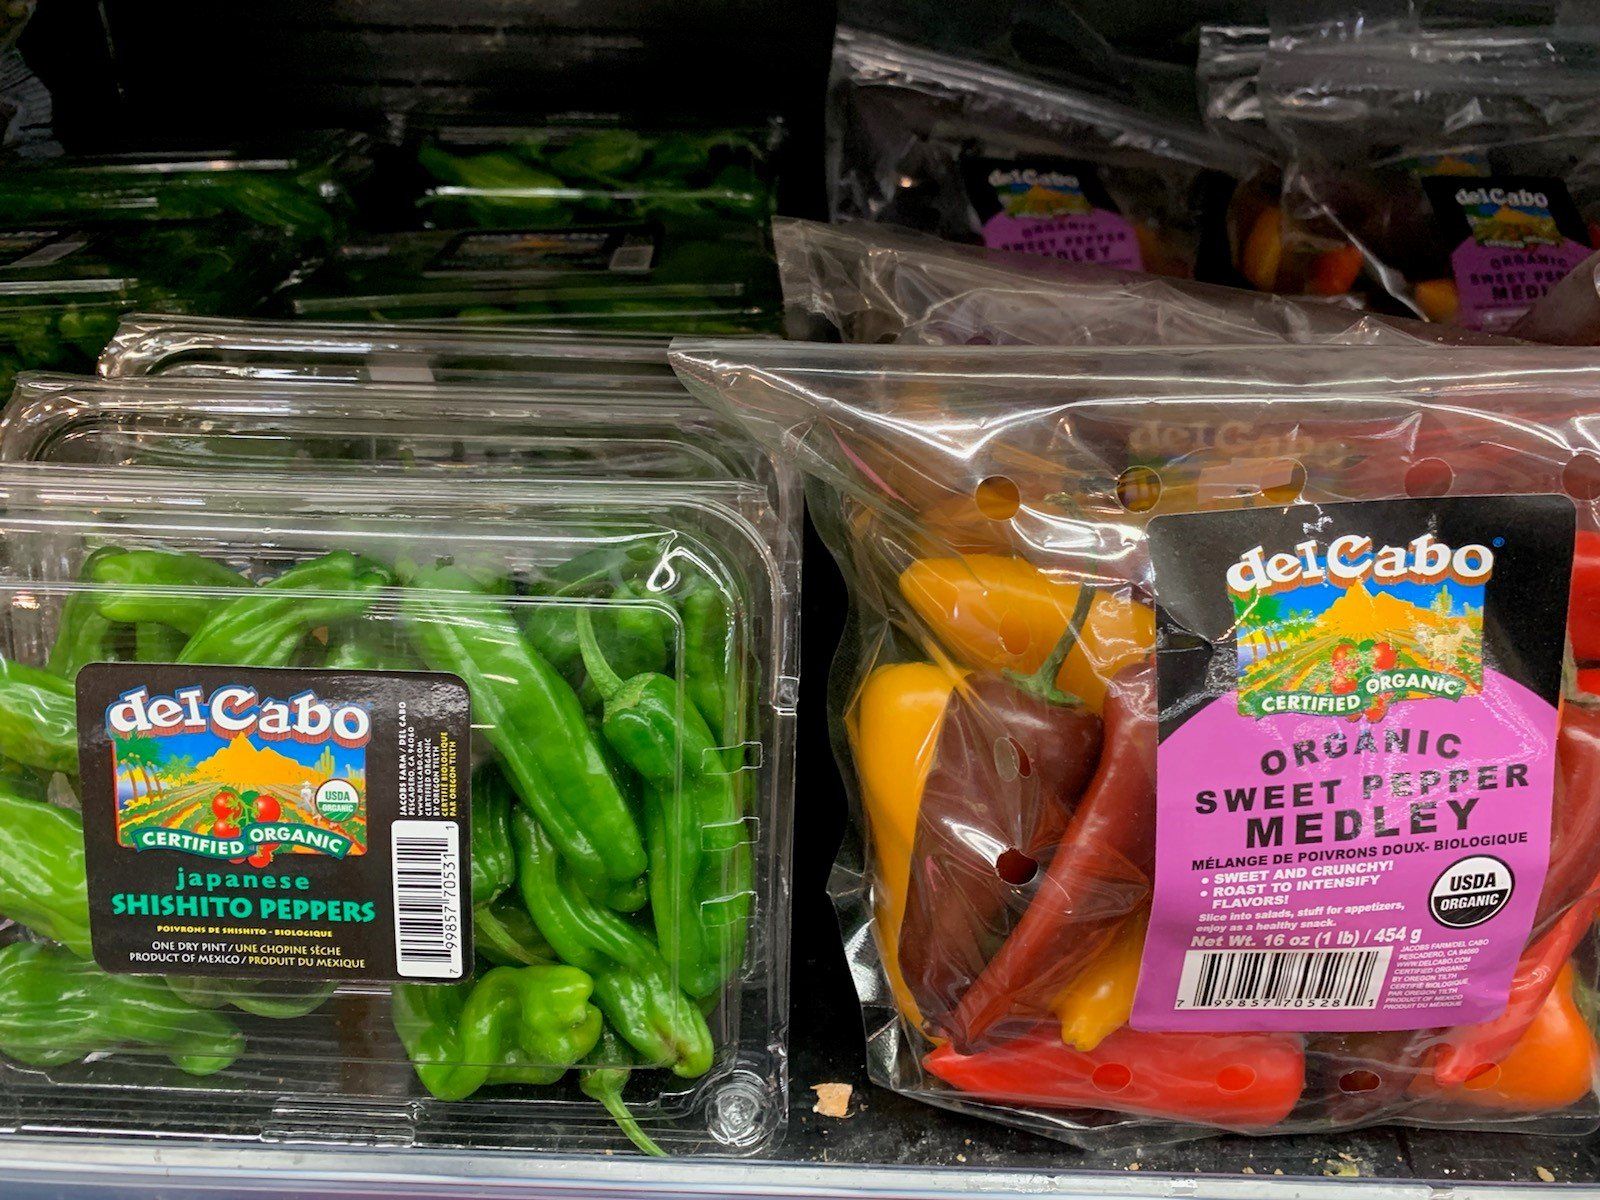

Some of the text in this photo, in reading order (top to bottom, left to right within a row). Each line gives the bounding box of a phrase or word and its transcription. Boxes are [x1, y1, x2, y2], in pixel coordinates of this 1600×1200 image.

[1261, 673, 1459, 712] CERTIFIED ORGANIC
[398, 701, 406, 727] CABO
[408, 756, 415, 767] CA
[440, 731, 448, 782] BIOLOGIQUE
[1260, 728, 1462, 776] ORGANIC
[399, 754, 407, 780] FARM
[325, 790, 350, 802] USDA
[399, 782, 407, 816] JACOBS
[424, 776, 432, 816] CERTIFIED
[1195, 763, 1530, 815] SWEET PEPPER
[321, 803, 354, 814] ORGANIC
[433, 805, 440, 816] BY
[449, 801, 457, 817] PAR
[1246, 797, 1480, 849] MEDLEY
[142, 827, 343, 855] CERTIFIED ORGANIC
[1191, 857, 1268, 871] MÉLANGE
[1273, 853, 1293, 865] DE
[1300, 846, 1378, 863] POIVRONS
[1434, 832, 1528, 851] BIOLOGIQUE
[175, 866, 310, 892] japanese
[443, 853, 456, 898] 70531
[1214, 860, 1394, 884] SWEET AND CRUNCHY!
[1449, 872, 1496, 892] USDA
[1213, 874, 1381, 897] ROAST TO INTENSIFY
[111, 893, 376, 923] SHISHITO PEPPERS
[1199, 902, 1405, 922] Slice into salads, stuff for appetizers,
[1212, 895, 1289, 909] FLAVORS!
[1440, 893, 1499, 911] ORGANIC
[156, 925, 206, 934] POIVRONS
[222, 928, 267, 936] SHISHITO
[274, 929, 333, 938] BIOLOGIQUE
[444, 906, 458, 950] 99857
[1196, 924, 1227, 934] enjoy
[1256, 920, 1298, 931] healthy
[1300, 918, 1337, 928] snack.
[152, 941, 175, 951] ONE
[178, 942, 199, 952] DRY
[260, 945, 307, 956] CHOPINE
[310, 944, 341, 956] SÈCHE
[1190, 935, 1224, 947] Net
[1228, 935, 1256, 947] Wt.
[1264, 933, 1285, 946] 16
[1289, 936, 1310, 946] oz
[1314, 931, 1335, 948] (1
[1337, 929, 1360, 947] lb)
[1373, 927, 1407, 942] 454
[1410, 929, 1422, 944] g
[1468, 939, 1489, 947] CABO
[129, 952, 179, 964] PRODUCT
[182, 954, 195, 964] OF
[198, 954, 240, 965] MEXICO
[249, 956, 296, 967] PRODUIT
[298, 957, 313, 967] DU
[316, 957, 366, 969] MEXIQUE
[1394, 964, 1468, 975] CERTIFIED ORGANIC
[1176, 999, 1375, 1008] 7 99857 70528 1
